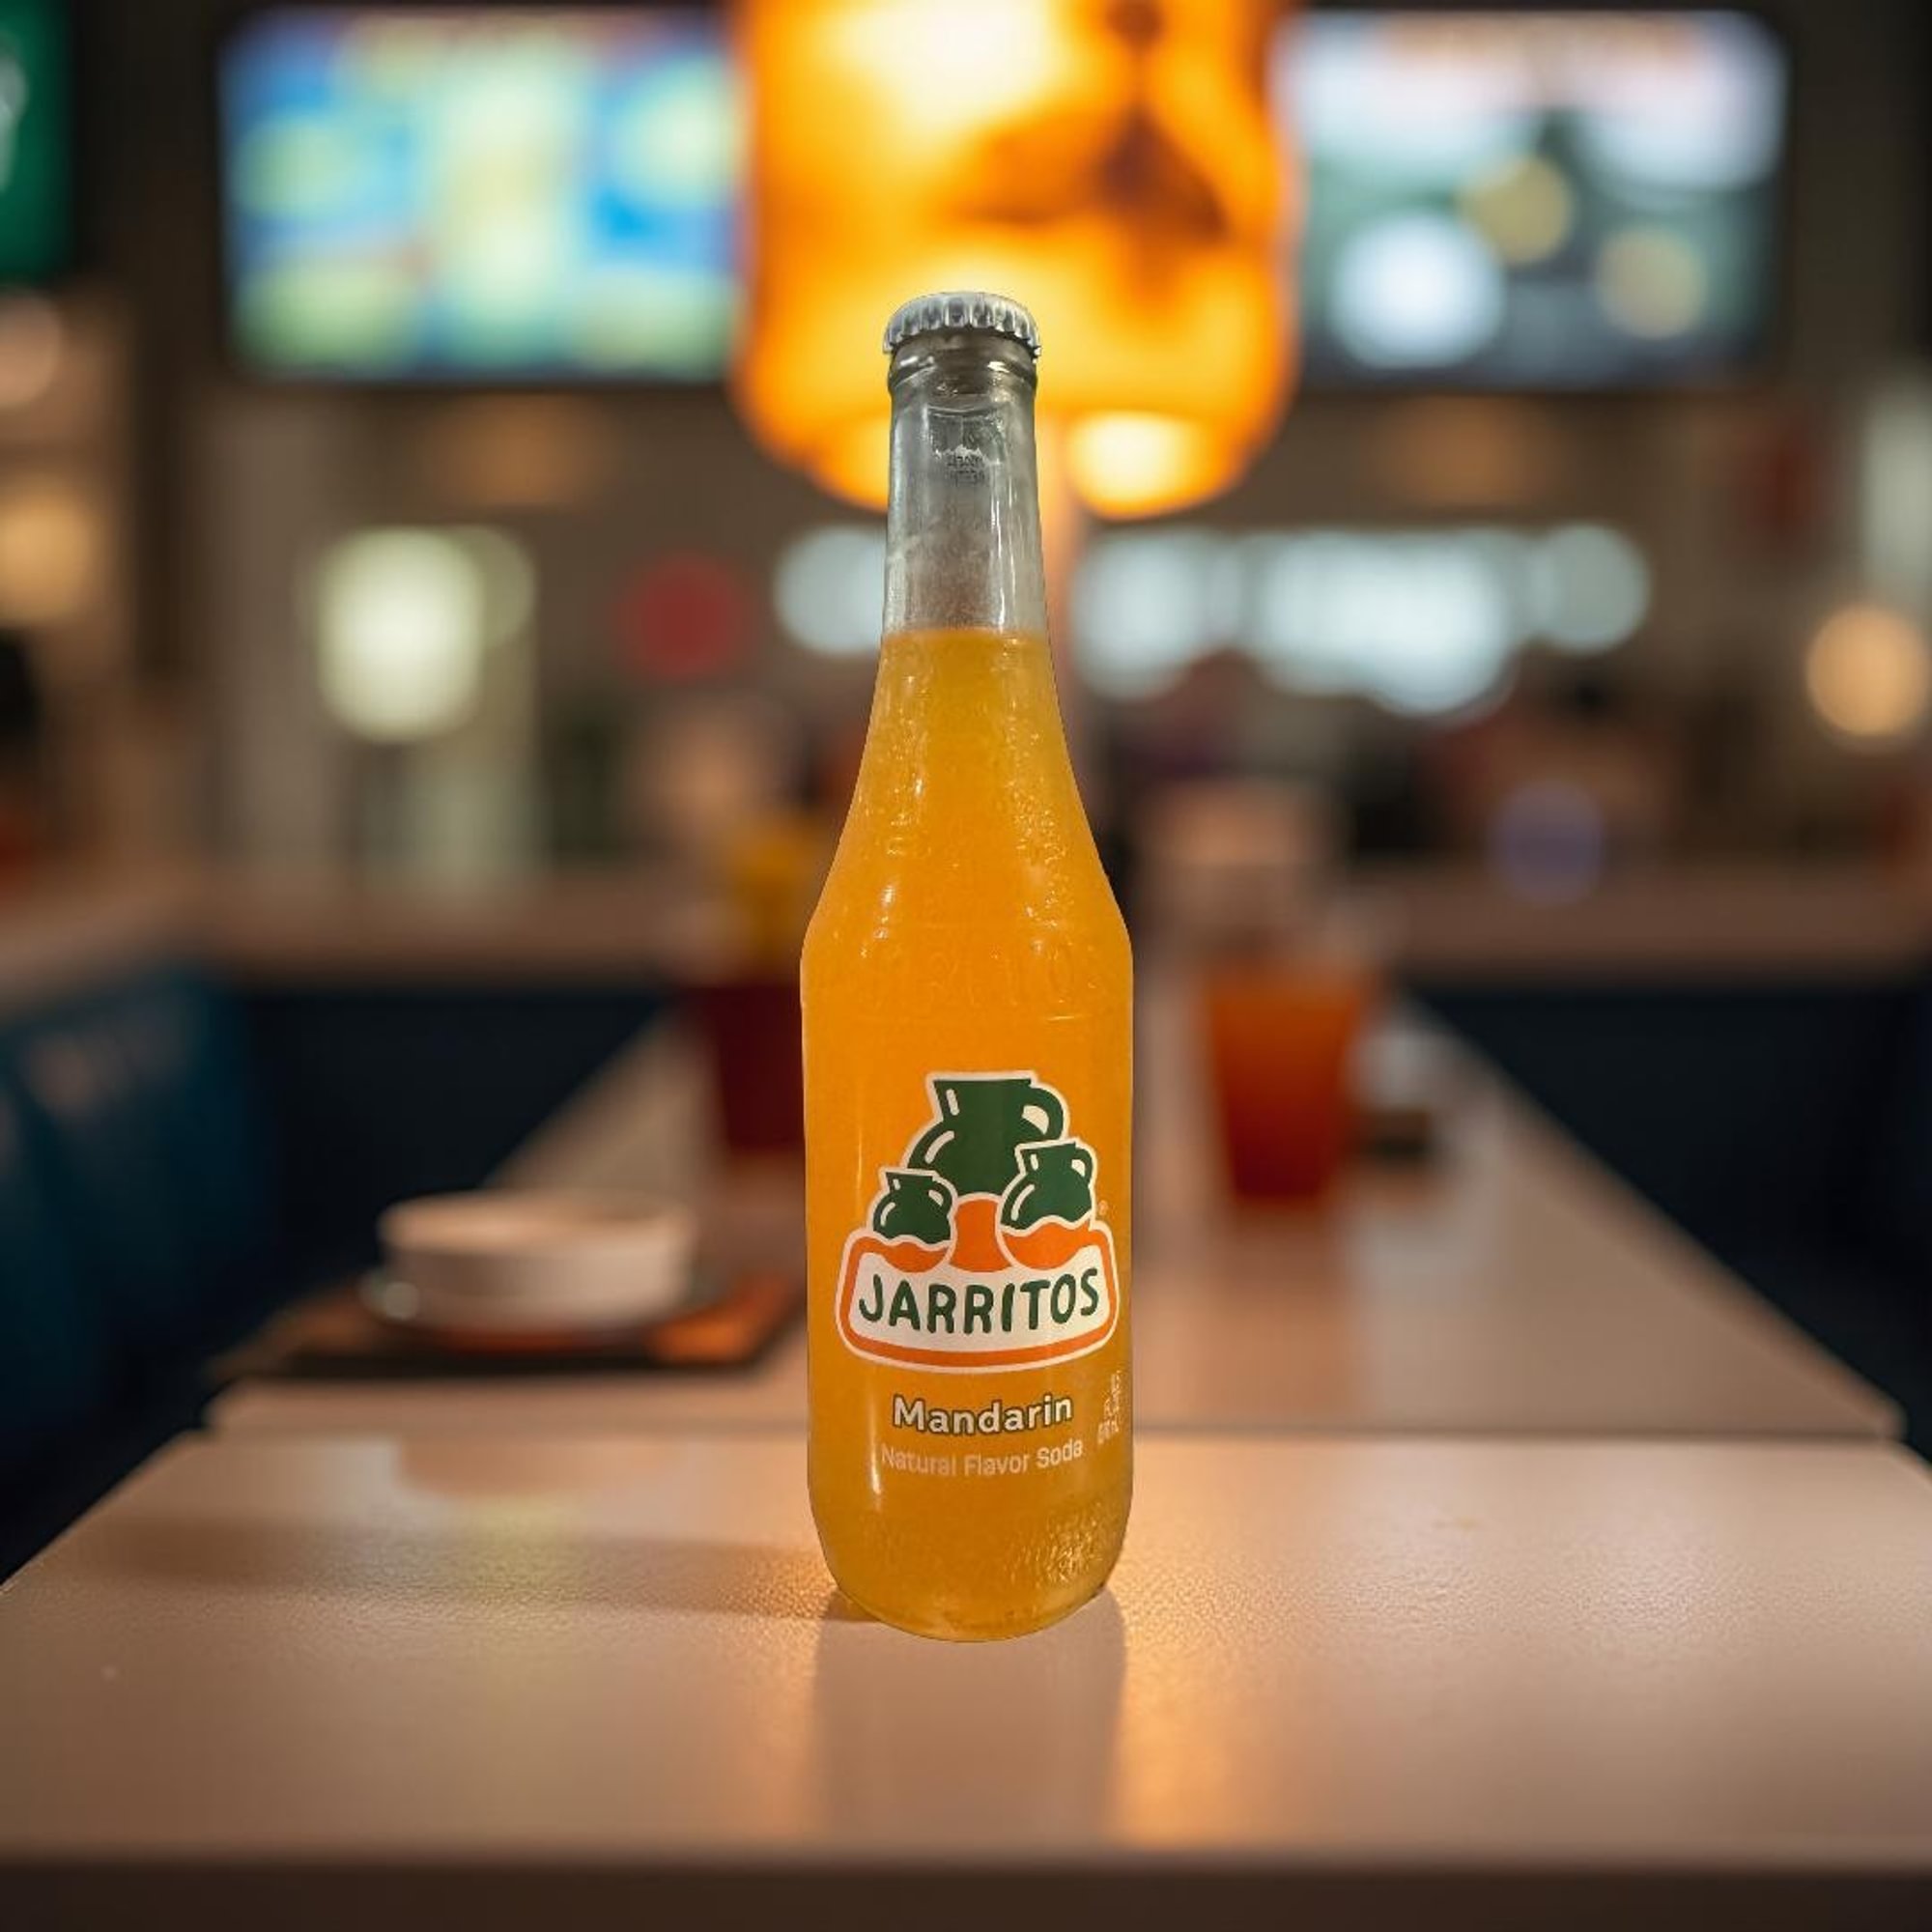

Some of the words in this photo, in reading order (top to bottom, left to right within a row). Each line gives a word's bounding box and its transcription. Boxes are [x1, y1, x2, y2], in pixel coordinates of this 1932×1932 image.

[859, 1267, 1099, 1334] JARRITOS
[893, 1393, 1072, 1435] Mandarin
[880, 1443, 956, 1476] Natural
[963, 1453, 1030, 1477] Flavor
[1036, 1437, 1084, 1469] Soda
